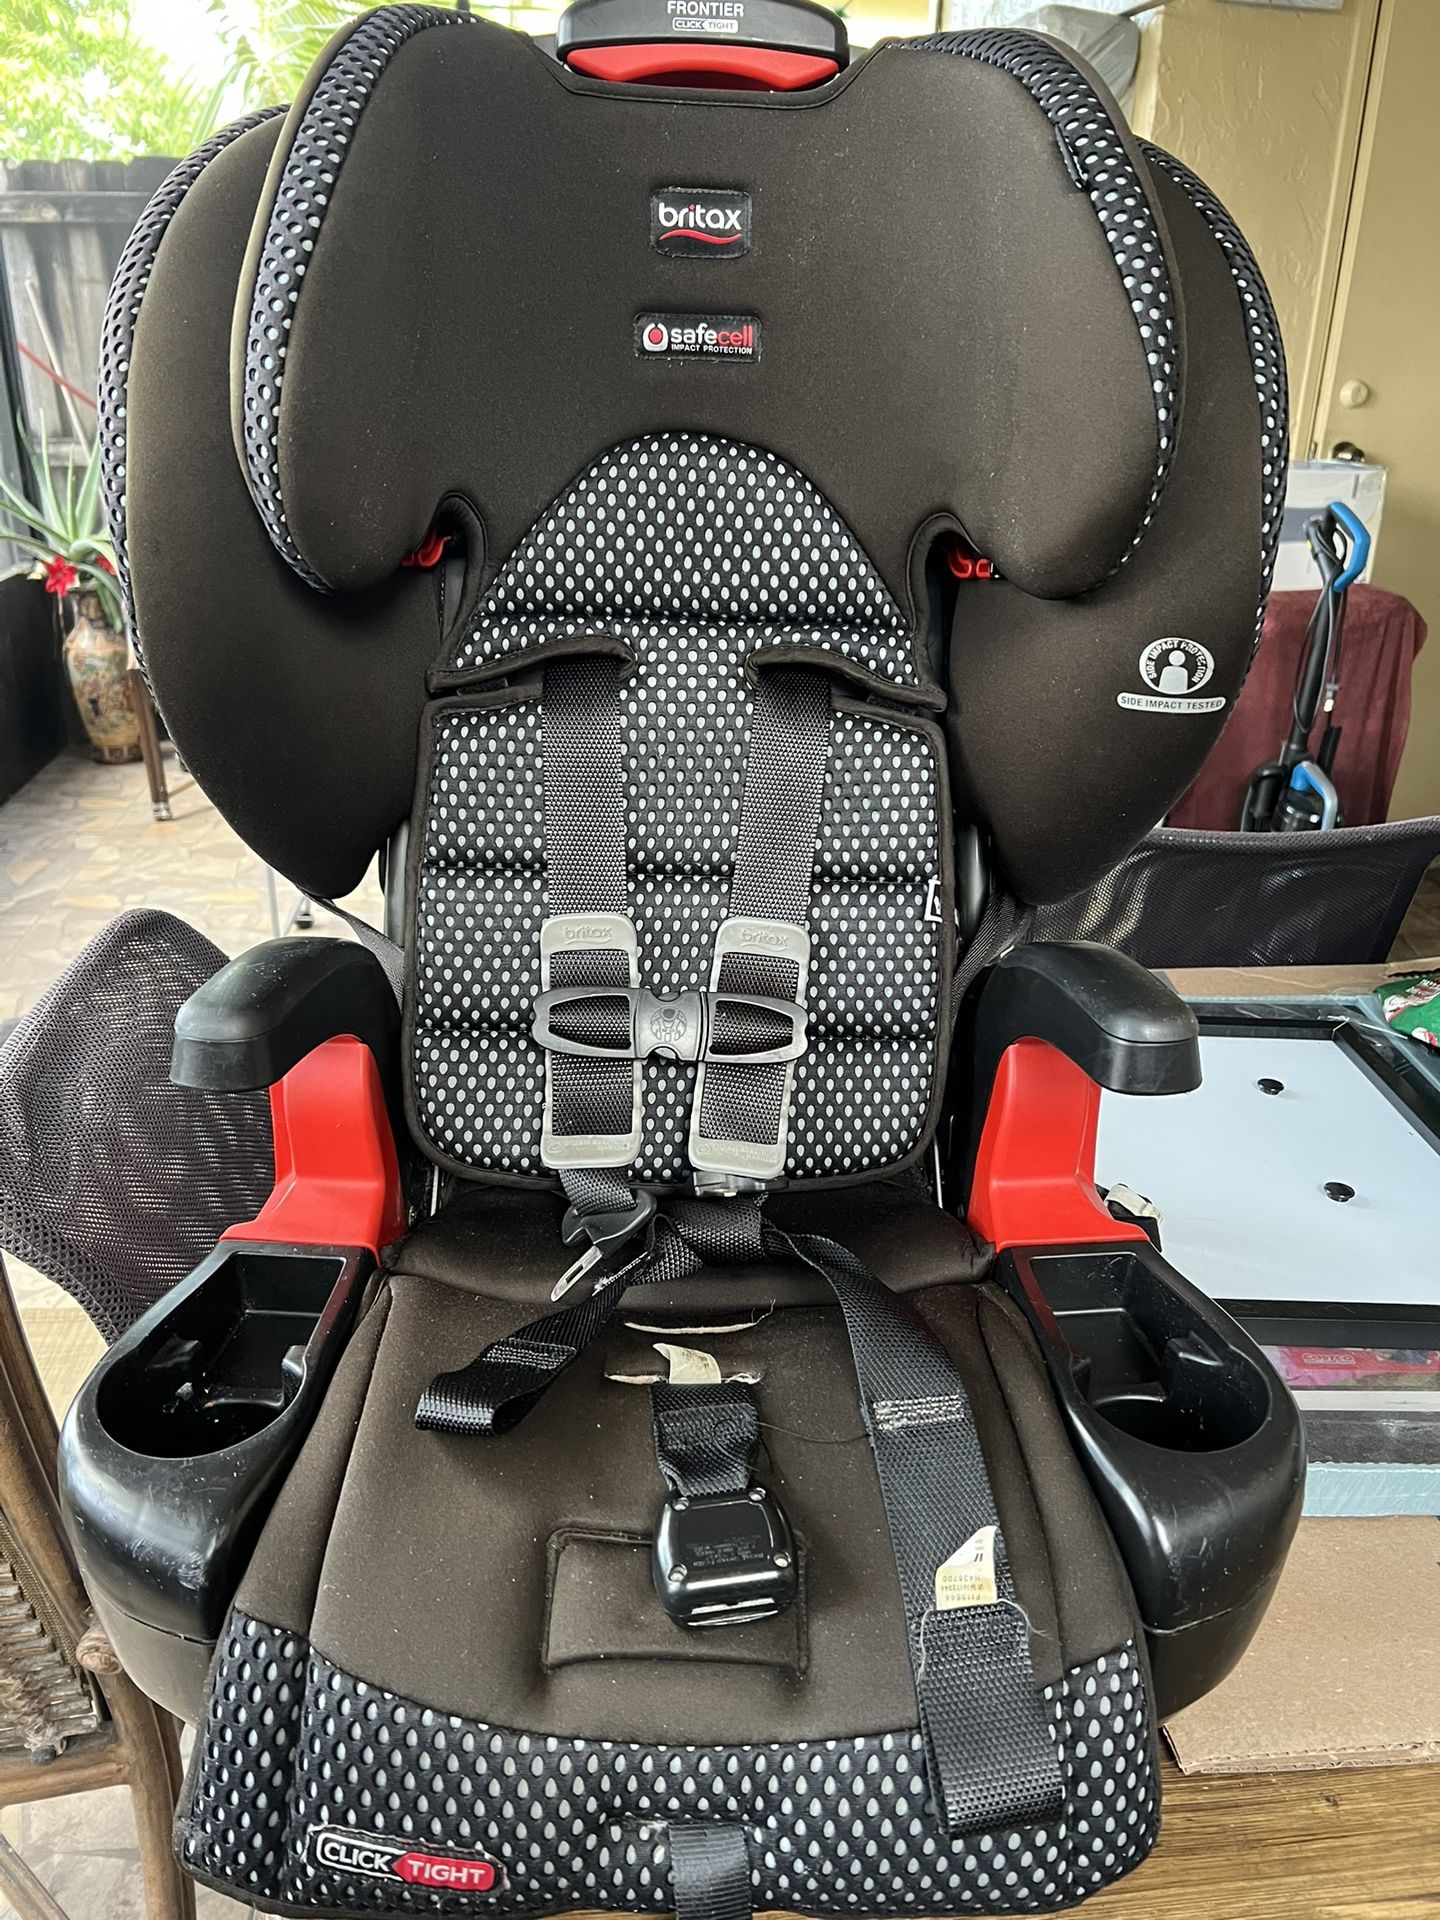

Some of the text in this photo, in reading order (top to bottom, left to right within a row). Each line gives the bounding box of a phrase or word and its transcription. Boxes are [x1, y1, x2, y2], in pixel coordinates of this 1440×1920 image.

[667, 1, 744, 17] FRONTIER
[675, 20, 734, 30] CLICK TIGHT
[658, 202, 742, 230] britax
[670, 323, 753, 346] safecell
[671, 344, 753, 355] IMPACT PROTECTION
[1146, 640, 1208, 683] SIDE IMPACT PROTECTION
[1121, 695, 1223, 710] SIDE IMPACT TESTED
[563, 925, 612, 939] britax
[741, 928, 789, 946] britax
[324, 1842, 486, 1884] CLICK TIGHT
